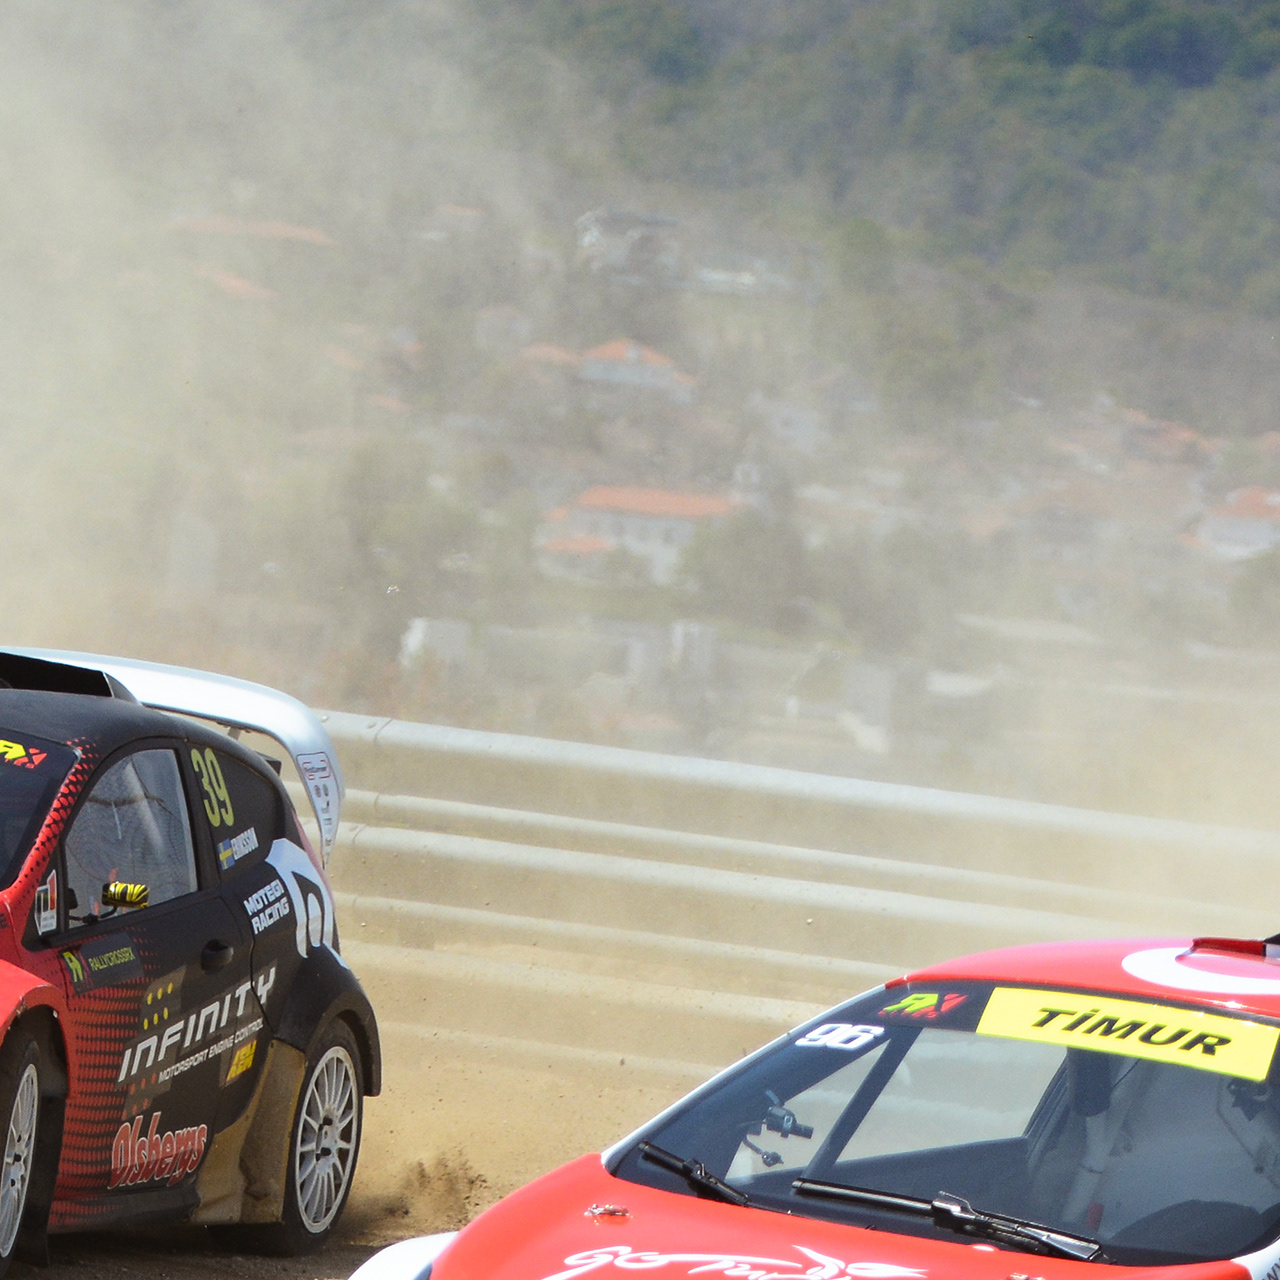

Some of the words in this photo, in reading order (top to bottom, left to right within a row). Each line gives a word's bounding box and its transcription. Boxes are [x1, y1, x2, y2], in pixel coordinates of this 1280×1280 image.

[190, 748, 235, 828] 39
[243, 879, 285, 916] MOTEGI
[251, 896, 290, 935] RACING
[88, 946, 136, 972] RALLYCROSSRX
[118, 966, 276, 1083] INFINITY
[158, 1048, 209, 1084] MOTORSPORT
[208, 1034, 235, 1059] ENGINE
[234, 1016, 264, 1044] CONTROL
[794, 1023, 885, 1051] 96
[1031, 1006, 1233, 1057] TİMUR
[107, 1111, 208, 1190] Olsbergs
